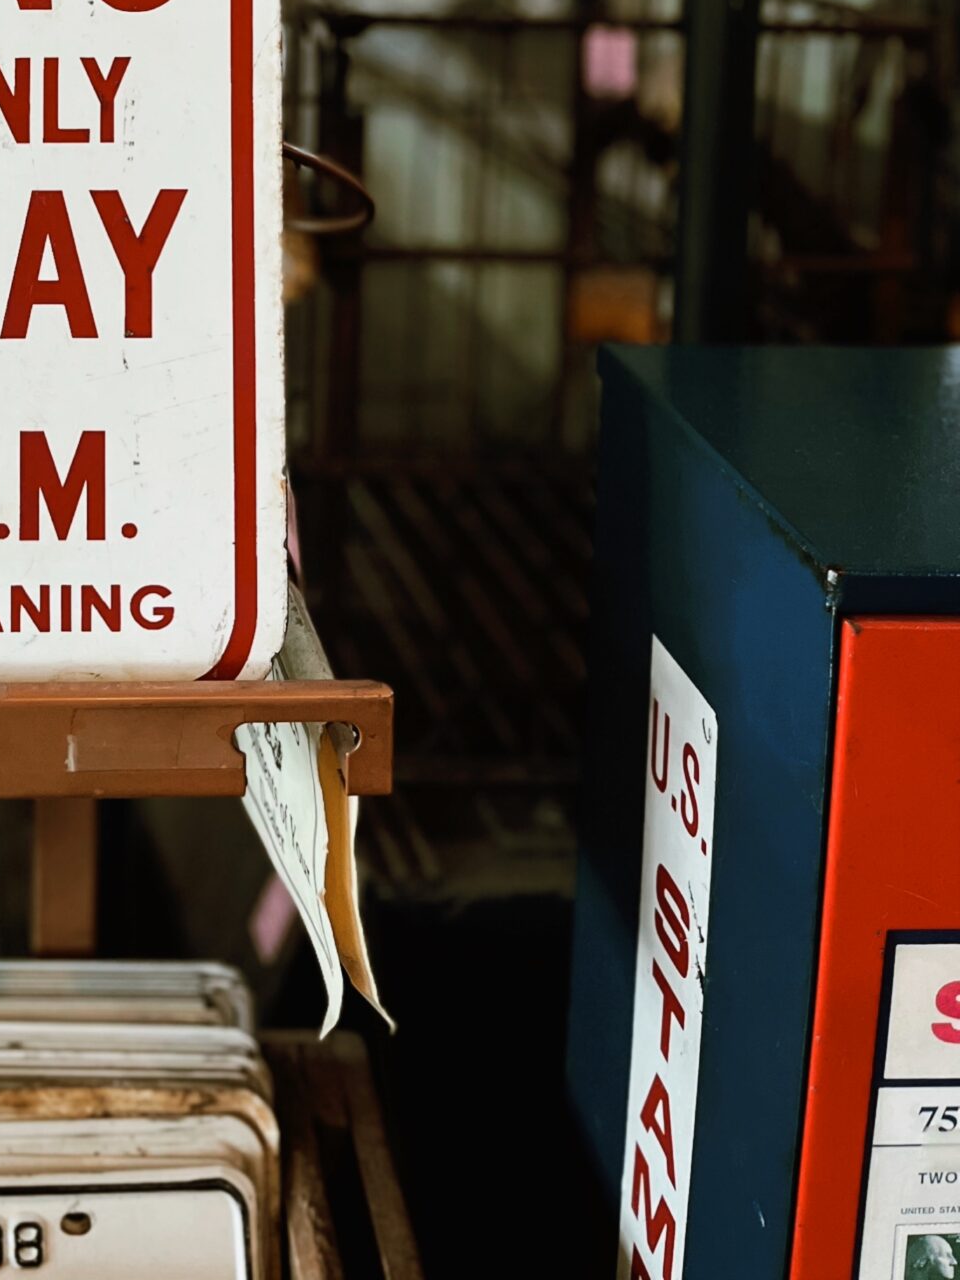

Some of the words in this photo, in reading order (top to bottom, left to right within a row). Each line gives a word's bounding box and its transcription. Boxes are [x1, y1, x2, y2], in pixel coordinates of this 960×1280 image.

[649, 697, 708, 856] U.S.
[918, 1171, 959, 1185] TWO
[900, 1207, 936, 1216] UNITED
